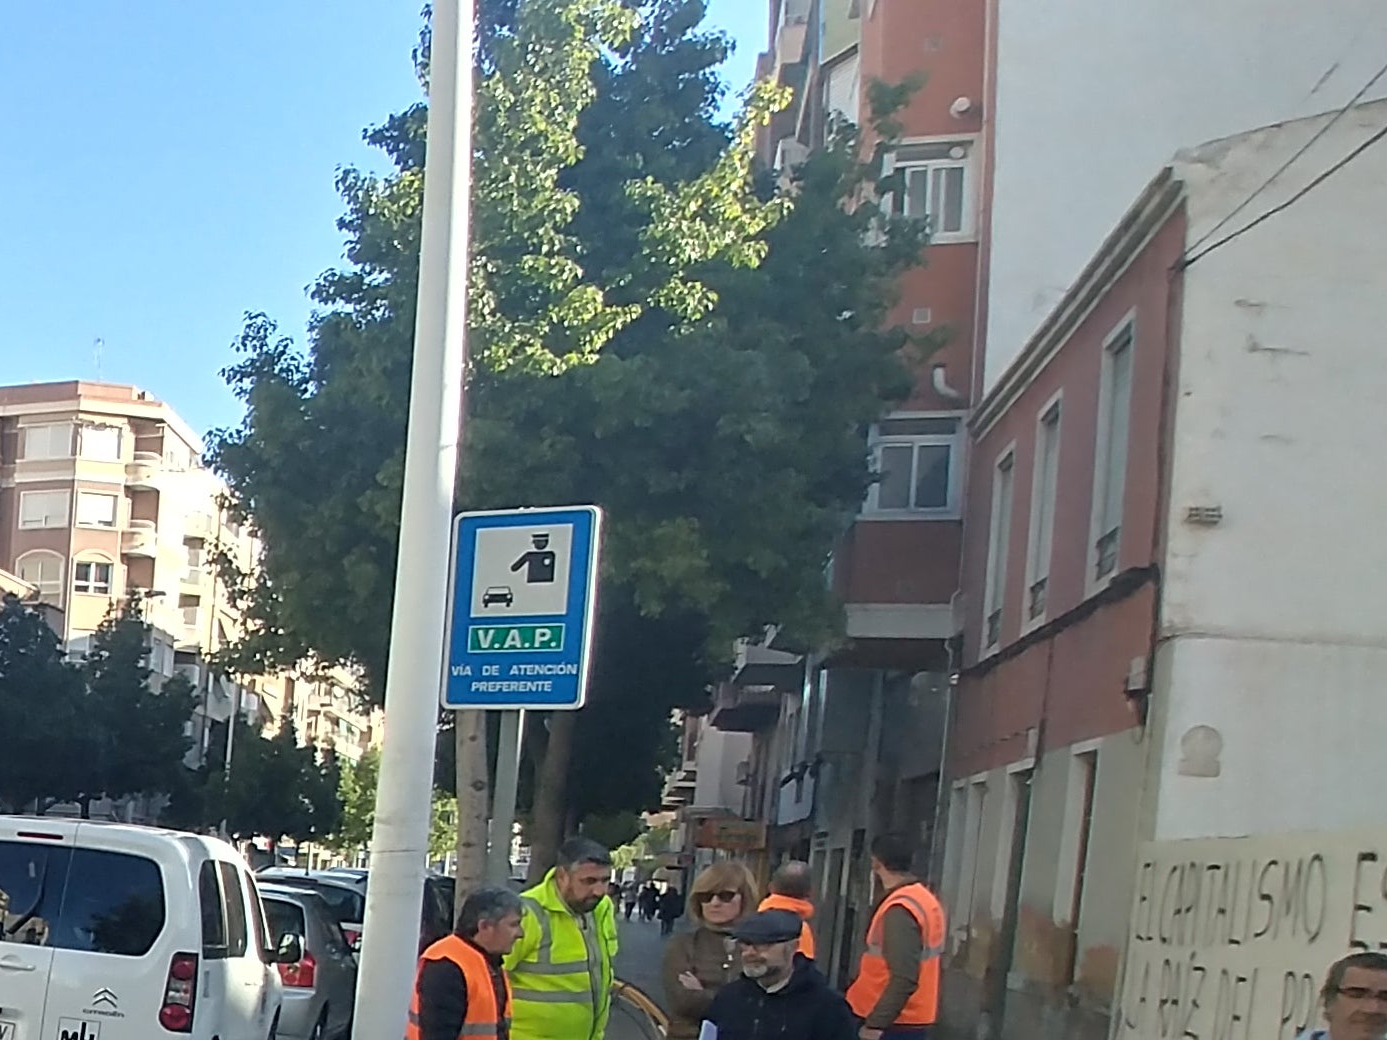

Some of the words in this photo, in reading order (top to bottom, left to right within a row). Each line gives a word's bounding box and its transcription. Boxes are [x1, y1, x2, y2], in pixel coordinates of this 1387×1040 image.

[477, 628, 557, 649] V.A.P.
[451, 664, 472, 676] VÍA
[482, 665, 500, 676] DE
[509, 662, 578, 676] ATENCIÓN
[471, 681, 553, 692] PREFERENTE
